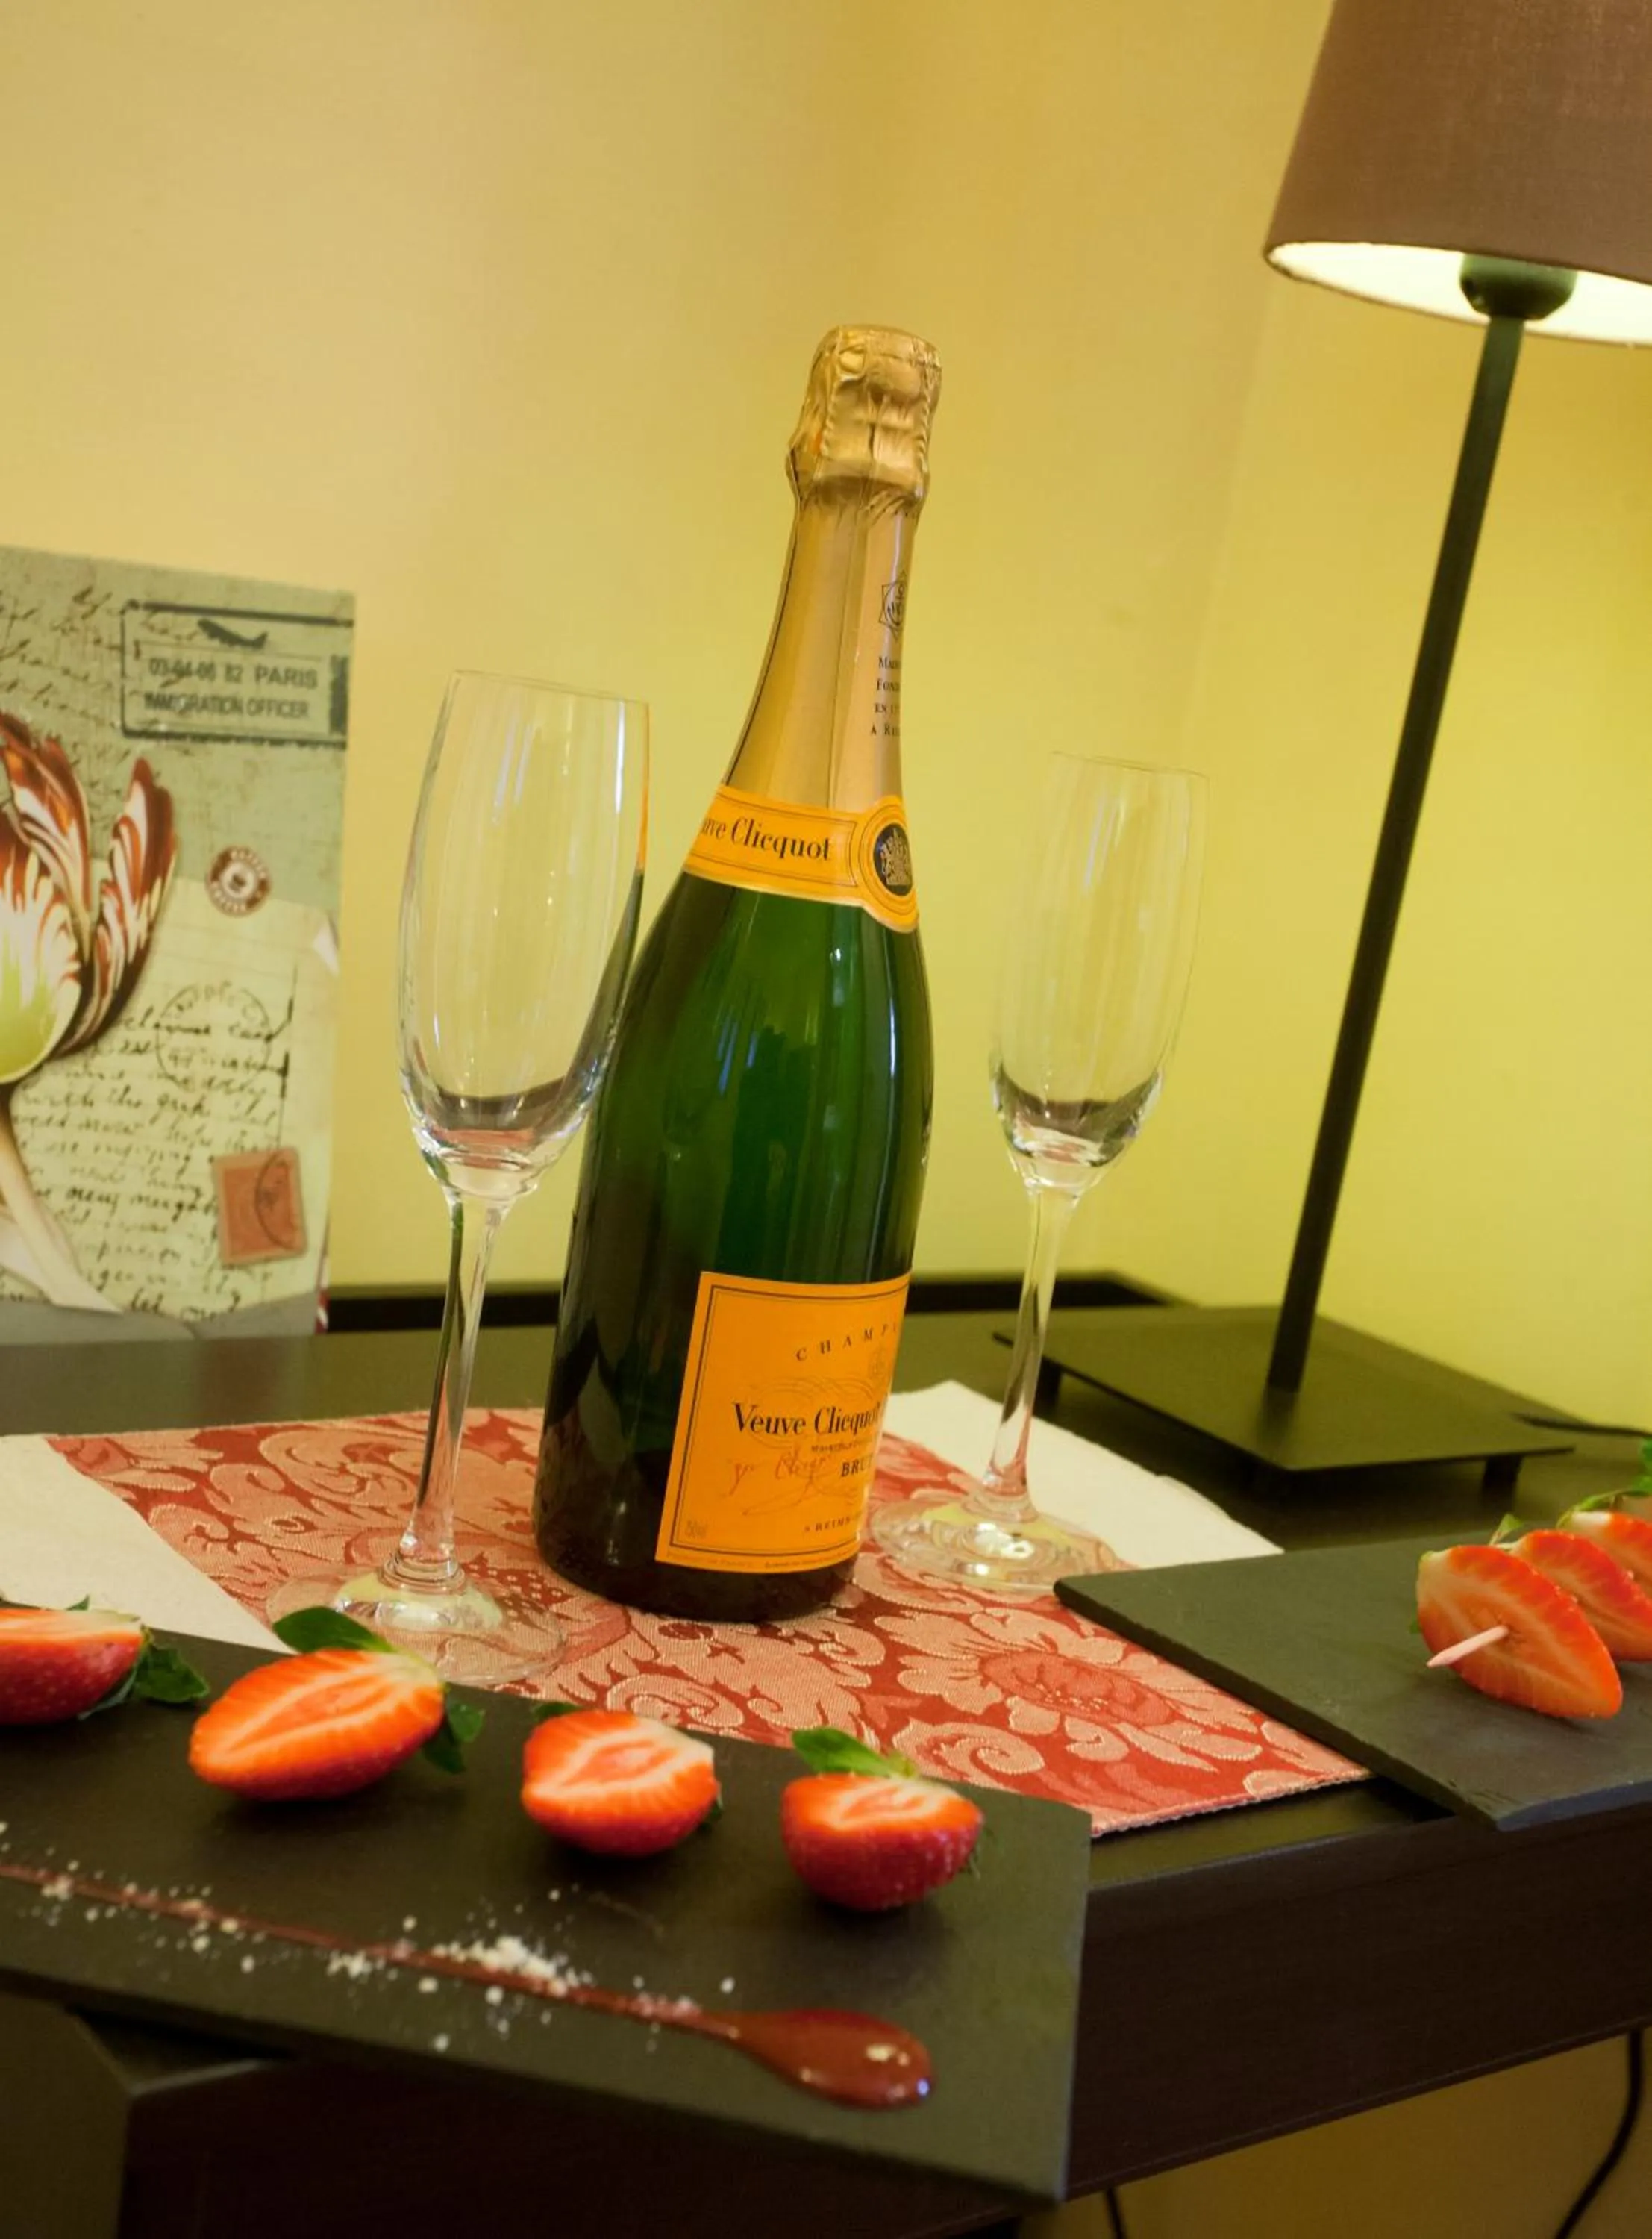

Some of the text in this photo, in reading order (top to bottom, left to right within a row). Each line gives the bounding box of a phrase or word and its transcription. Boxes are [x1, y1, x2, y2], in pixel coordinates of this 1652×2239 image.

[255, 663, 318, 690] PARIS
[144, 690, 310, 719] IMMIGRATION OFFICER
[730, 816, 830, 861] Clicquot
[731, 1400, 807, 1436] Veuve
